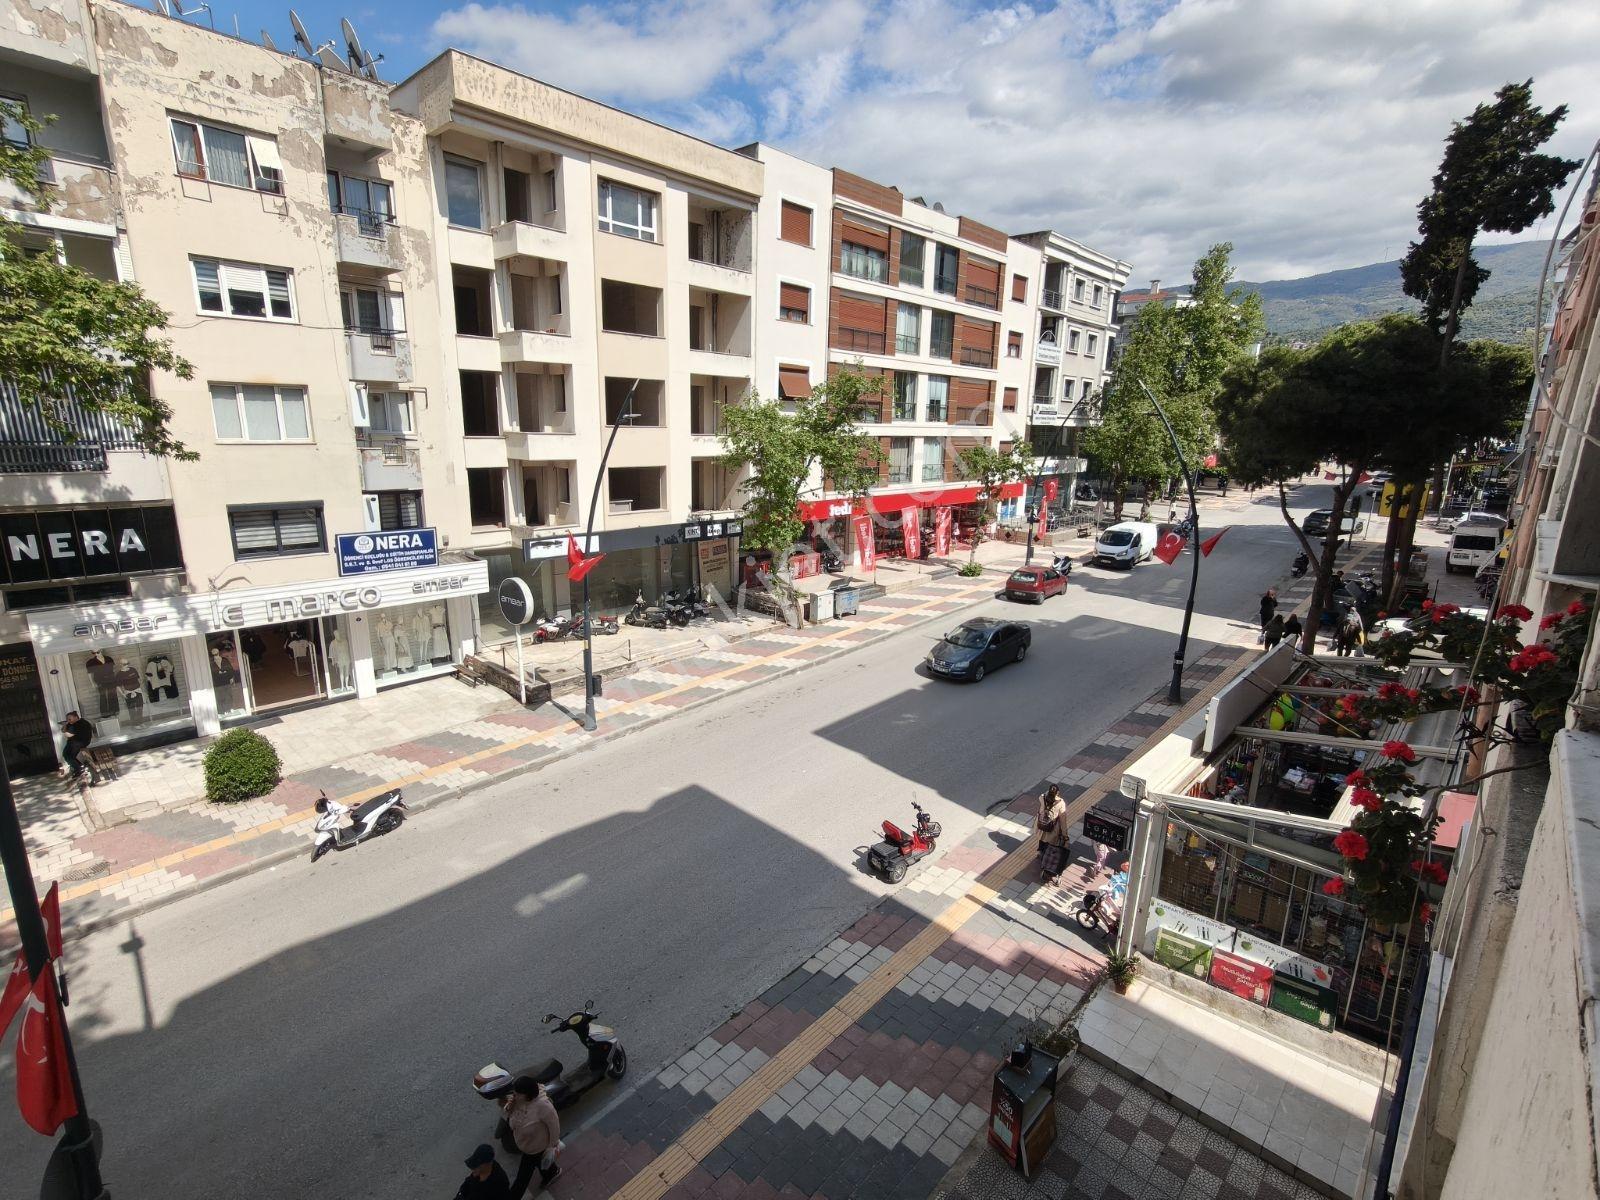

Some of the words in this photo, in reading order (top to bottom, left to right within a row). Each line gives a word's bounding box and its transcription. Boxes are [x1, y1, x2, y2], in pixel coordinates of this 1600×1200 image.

[8, 527, 147, 562] NERA
[376, 533, 424, 551] NERA
[266, 585, 383, 622] marco
